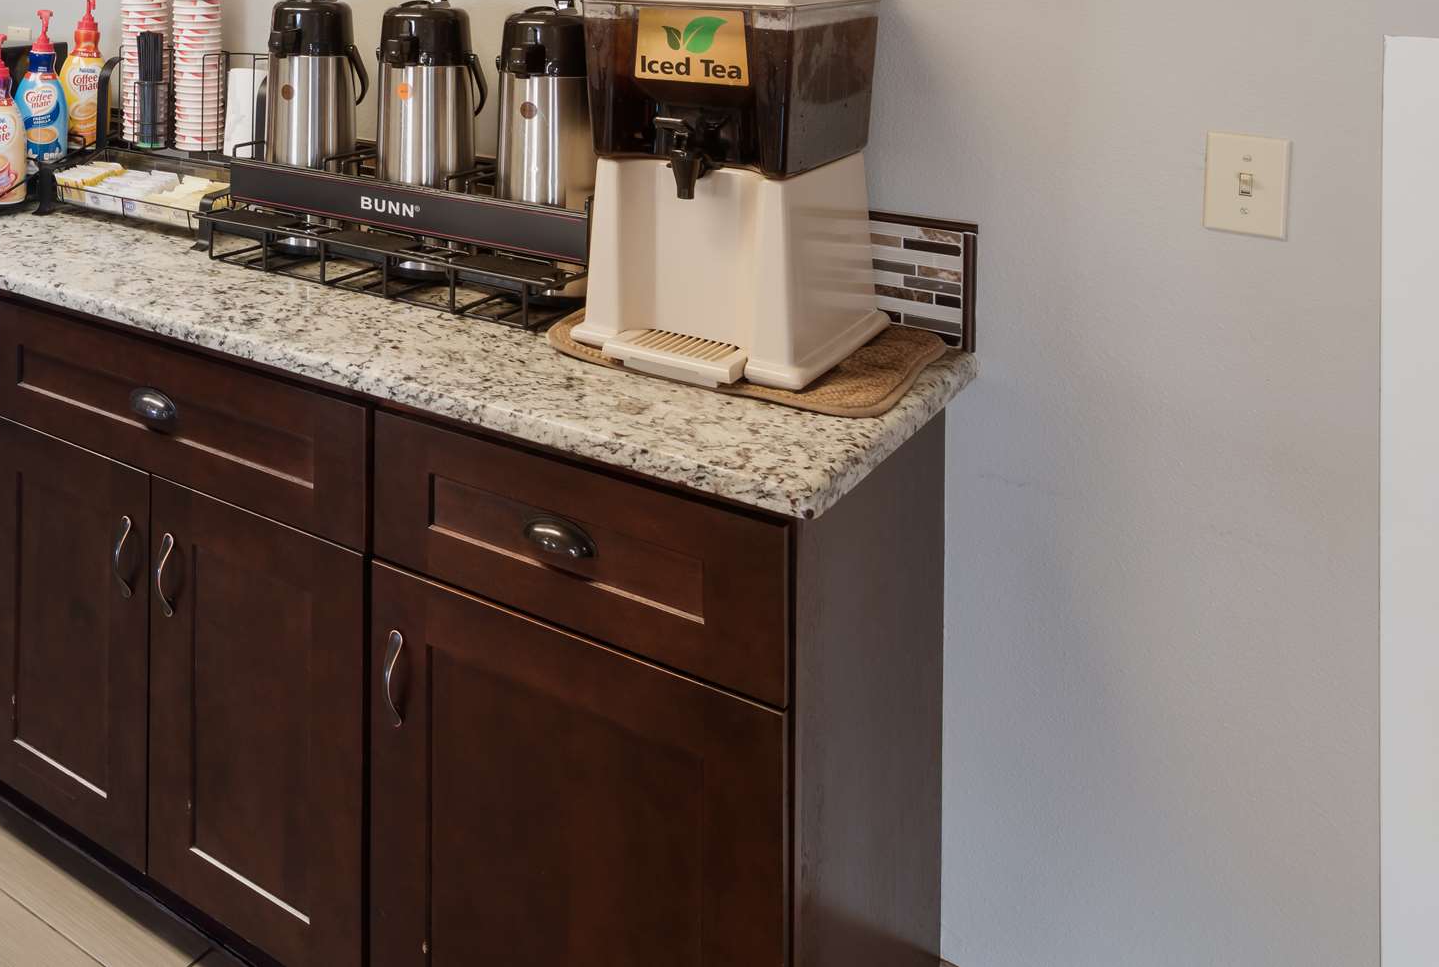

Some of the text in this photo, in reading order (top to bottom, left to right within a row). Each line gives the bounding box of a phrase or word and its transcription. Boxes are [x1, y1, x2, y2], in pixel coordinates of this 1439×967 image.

[640, 55, 742, 80] Iced Tea
[73, 74, 98, 87] Coffee
[25, 91, 53, 104] Coffee
[31, 99, 51, 109] mate
